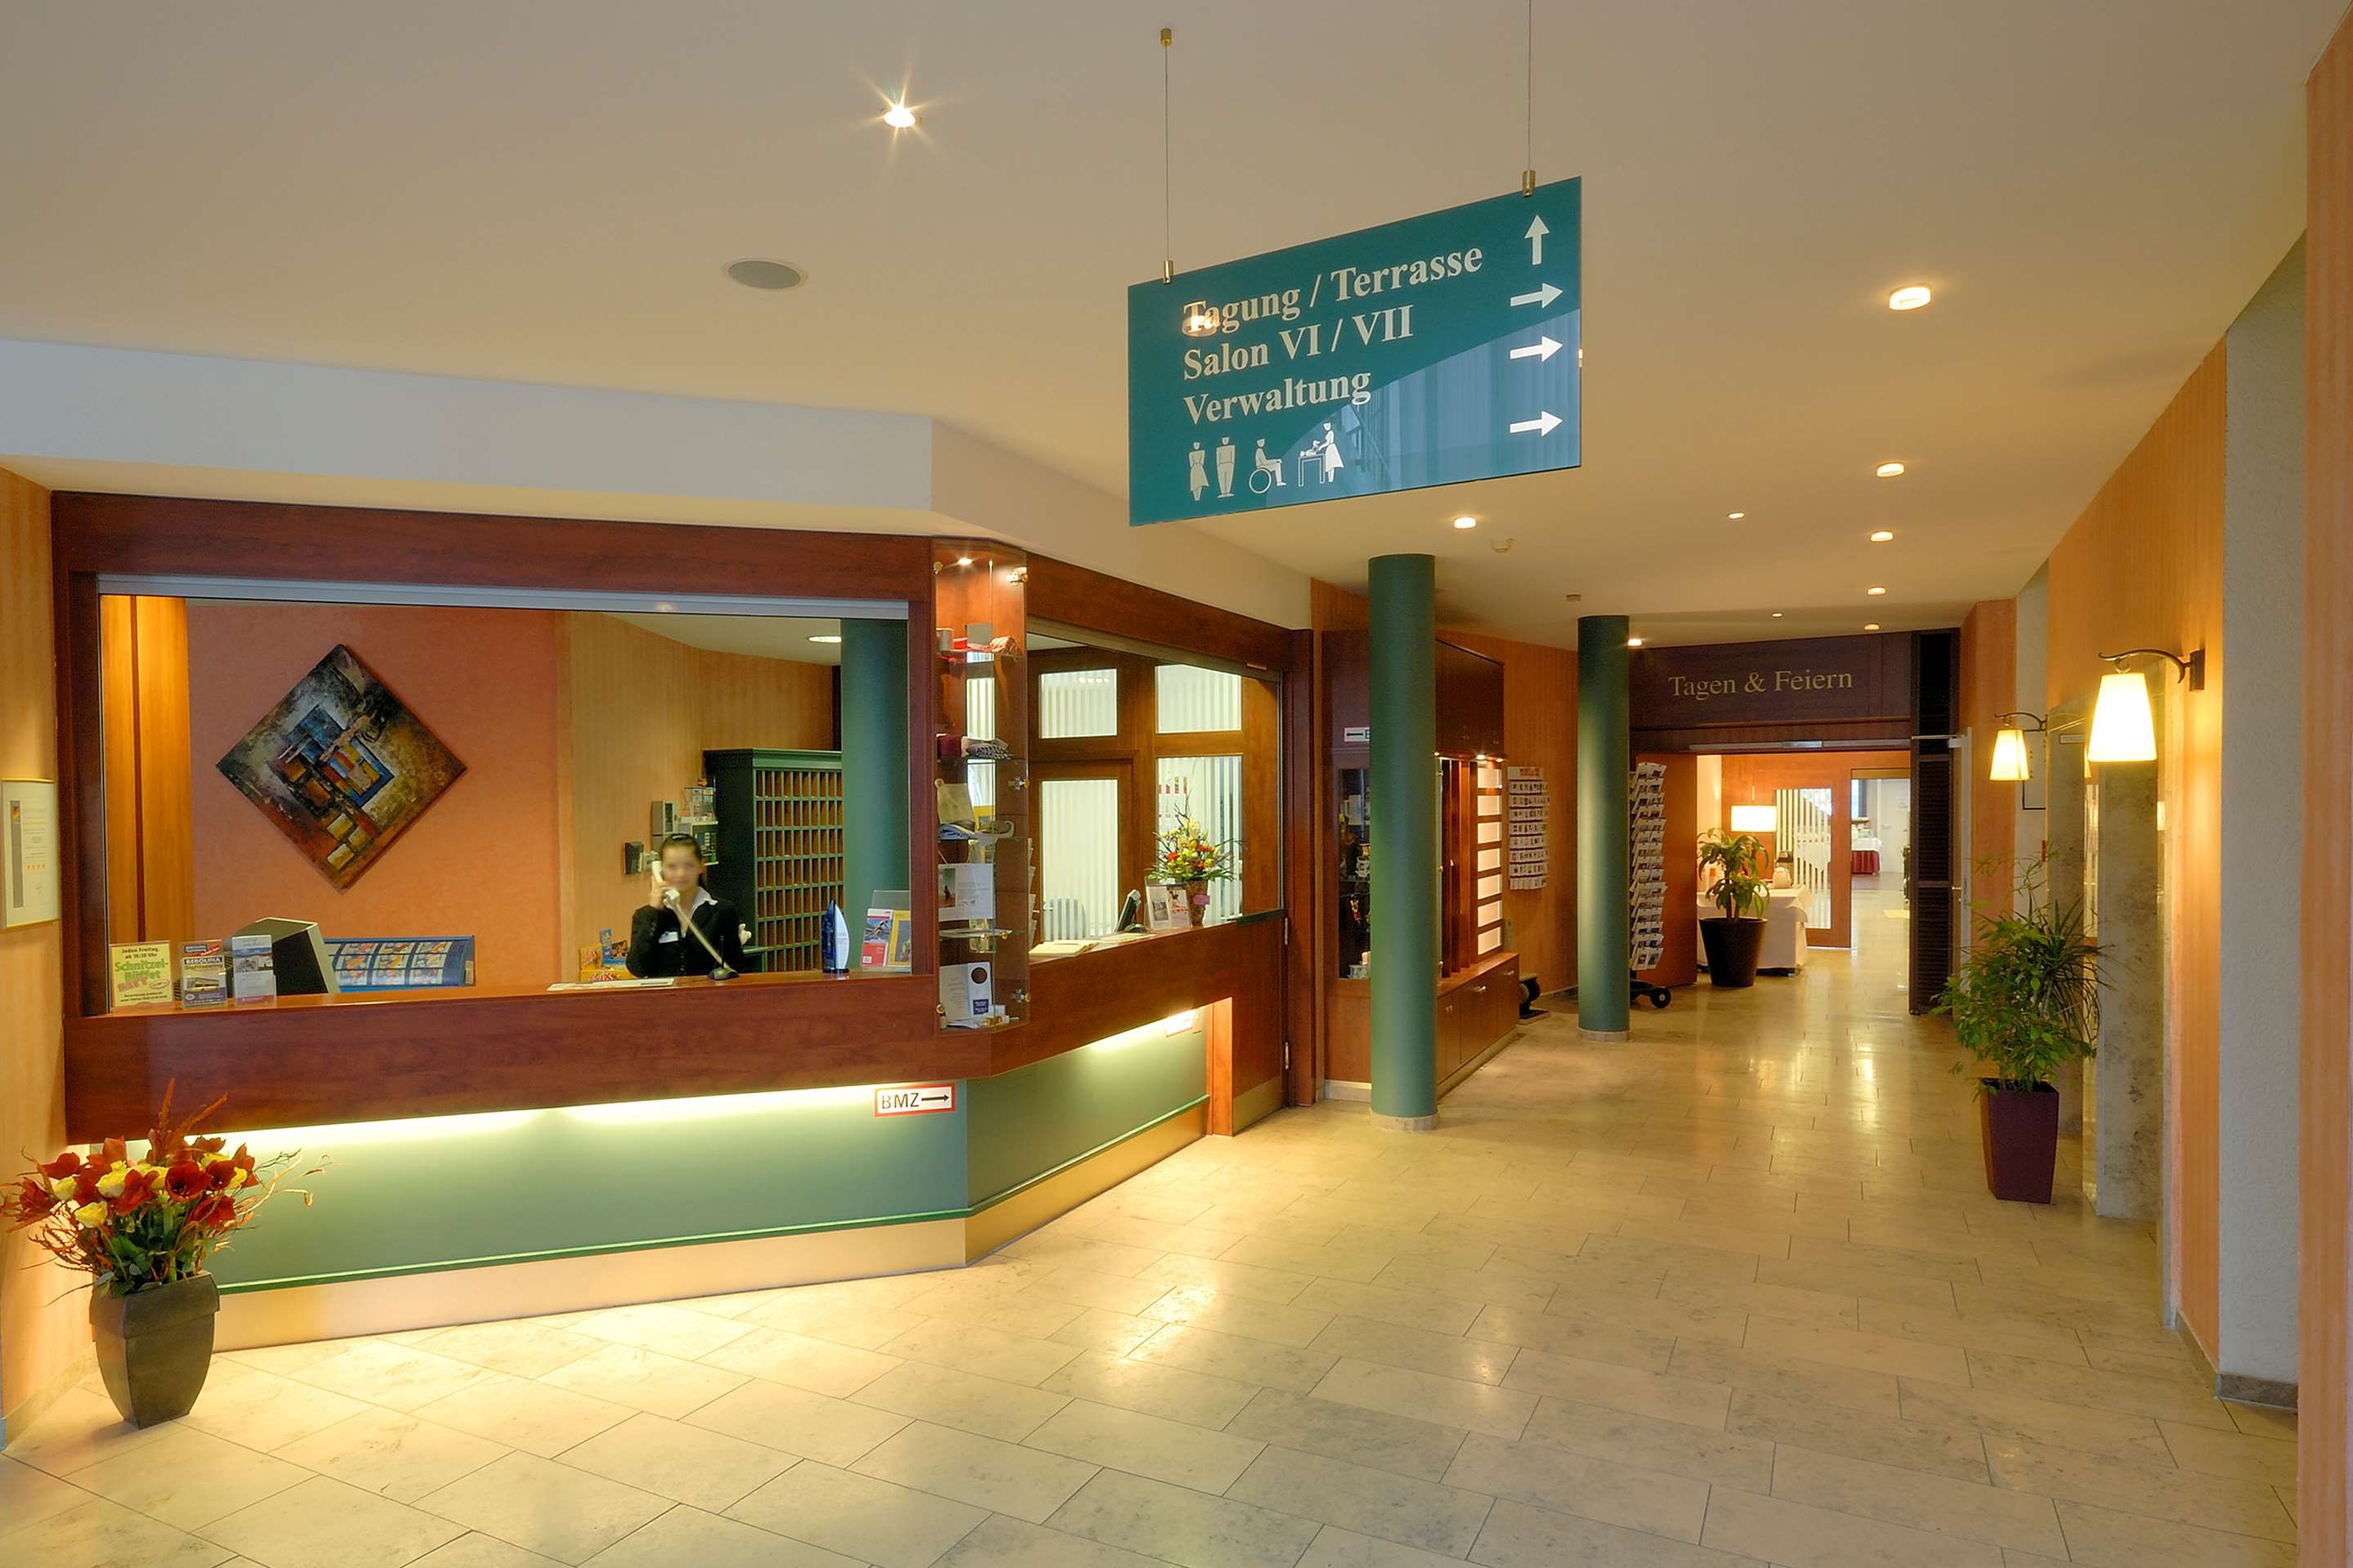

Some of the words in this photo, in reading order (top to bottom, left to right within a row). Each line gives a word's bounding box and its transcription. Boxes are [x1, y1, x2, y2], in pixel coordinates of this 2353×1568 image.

[1183, 288, 1301, 333] Tagung
[1309, 275, 1322, 308] /
[1331, 248, 1483, 302] Terrasse
[1184, 343, 1268, 380] Salon
[1278, 324, 1322, 360] VI
[1331, 319, 1344, 353] /
[1352, 305, 1414, 346] VII
[1184, 372, 1372, 426] Verwaltung
[1668, 676, 1736, 701] Tagen
[1744, 672, 1766, 694] &
[1774, 668, 1854, 692] Feiern
[882, 1092, 919, 1110] BMZ
